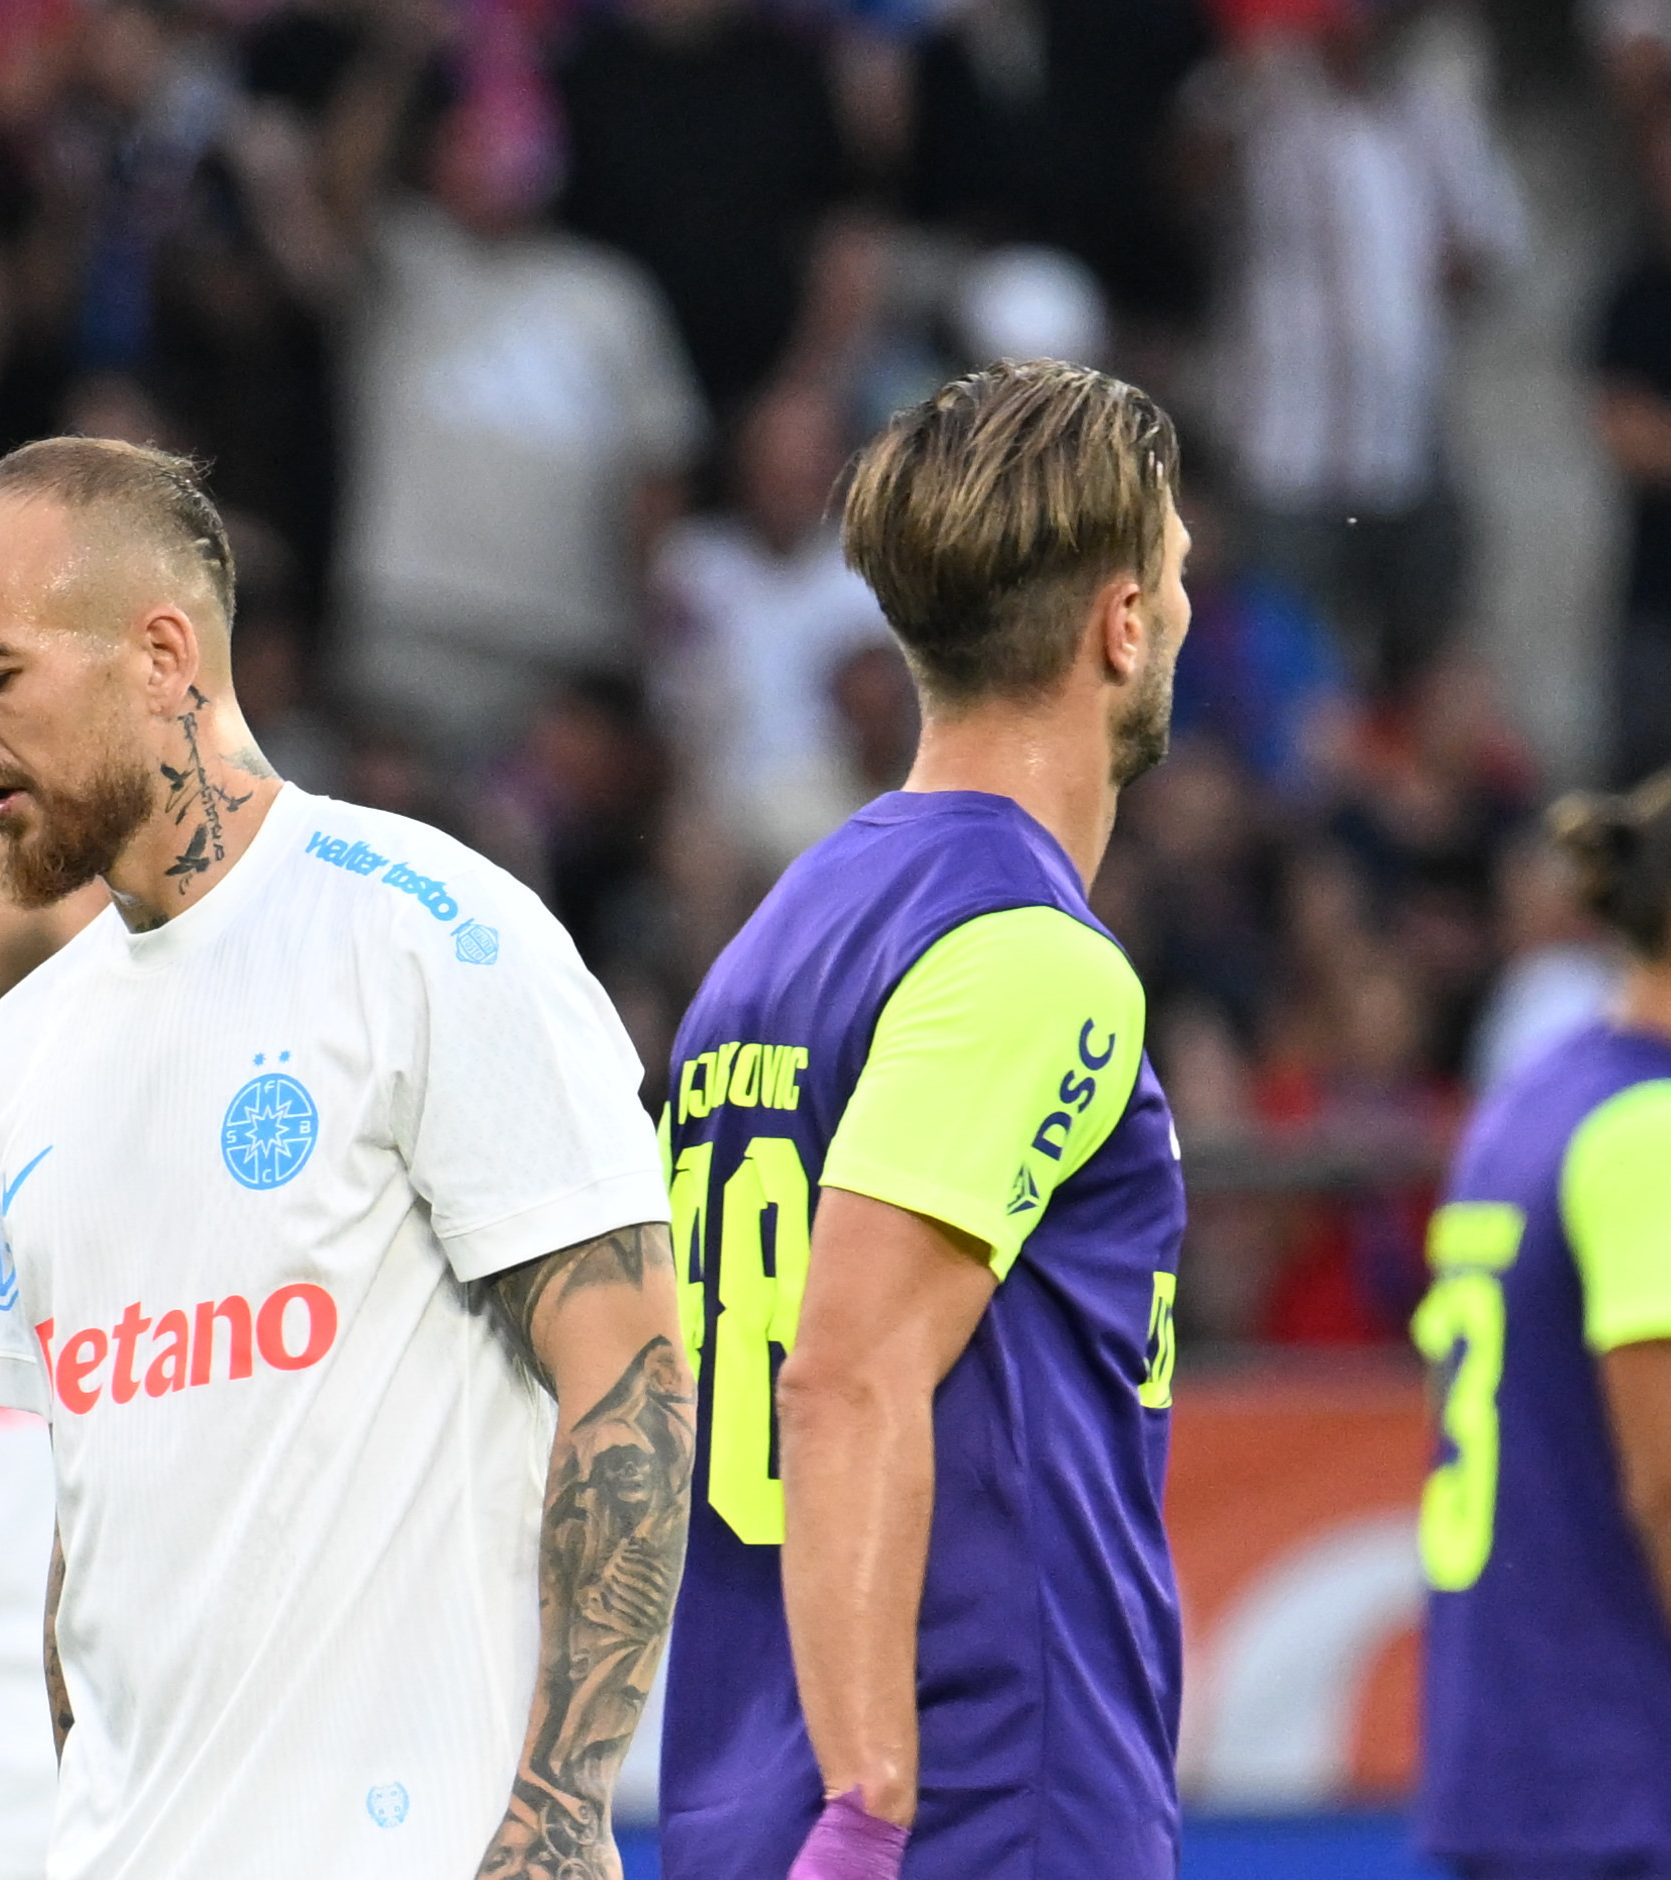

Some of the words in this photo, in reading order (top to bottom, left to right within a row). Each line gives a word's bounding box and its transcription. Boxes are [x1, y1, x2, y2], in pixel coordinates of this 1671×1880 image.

[381, 861, 459, 922] tosto
[1031, 1017, 1116, 1161] DSC
[35, 1282, 339, 1416] etano
